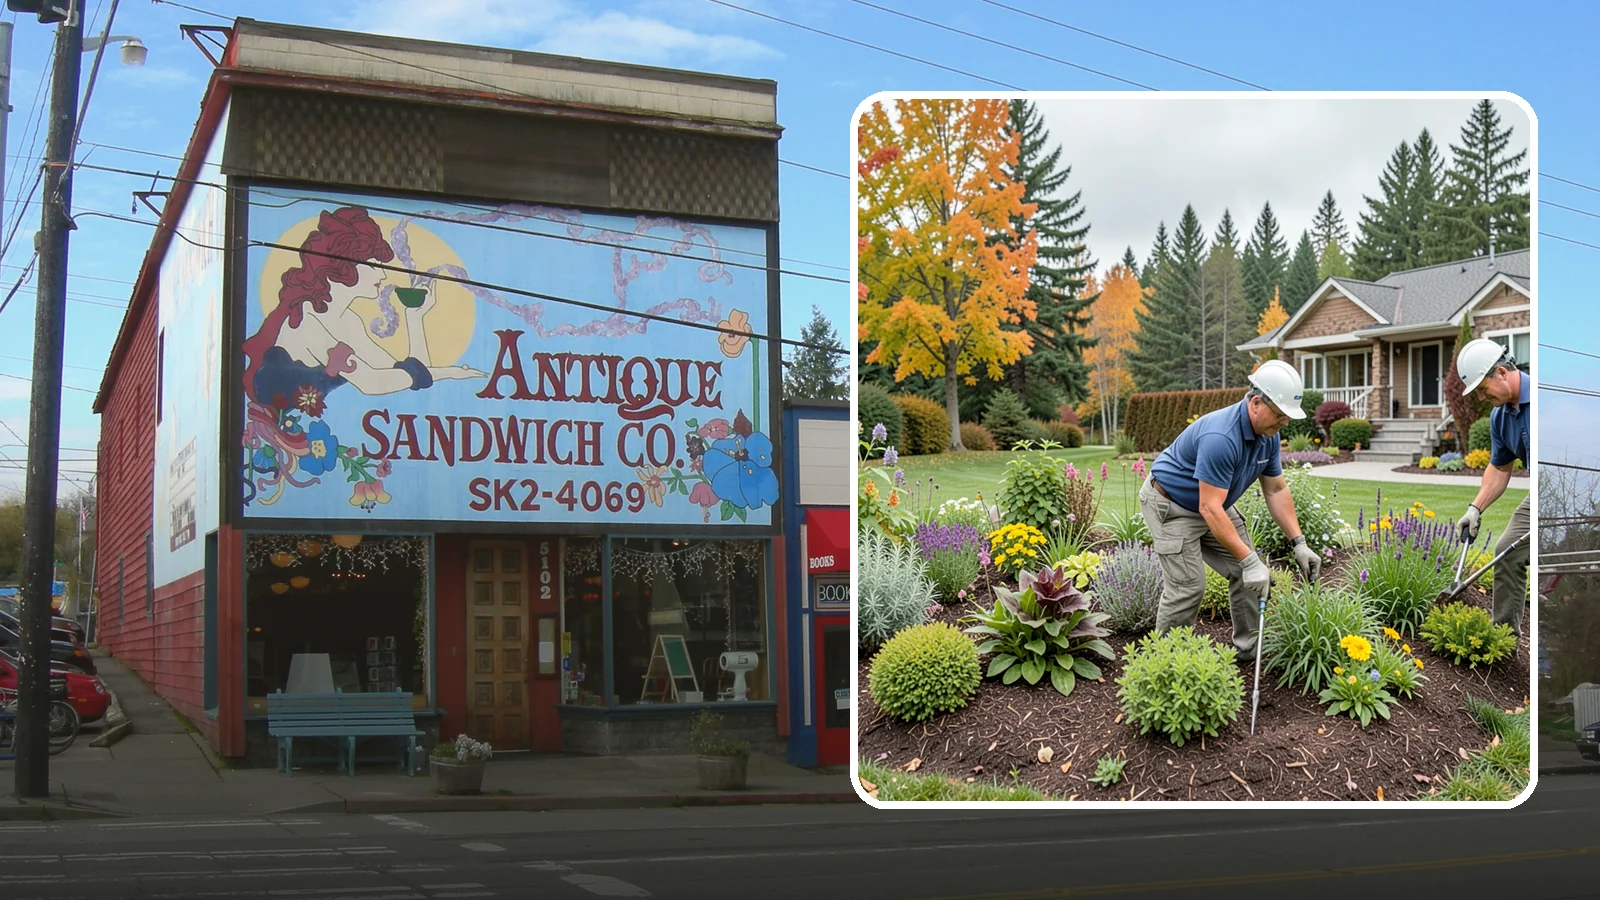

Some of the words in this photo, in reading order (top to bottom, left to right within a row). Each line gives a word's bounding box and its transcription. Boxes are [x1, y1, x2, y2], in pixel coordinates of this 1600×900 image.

[476, 329, 723, 420] ANTIQUE
[361, 409, 604, 467] SANDWICH
[617, 422, 685, 469] CO.
[469, 477, 645, 513] SK2-4069
[540, 542, 552, 599] 5102
[809, 555, 835, 569] BOOKS
